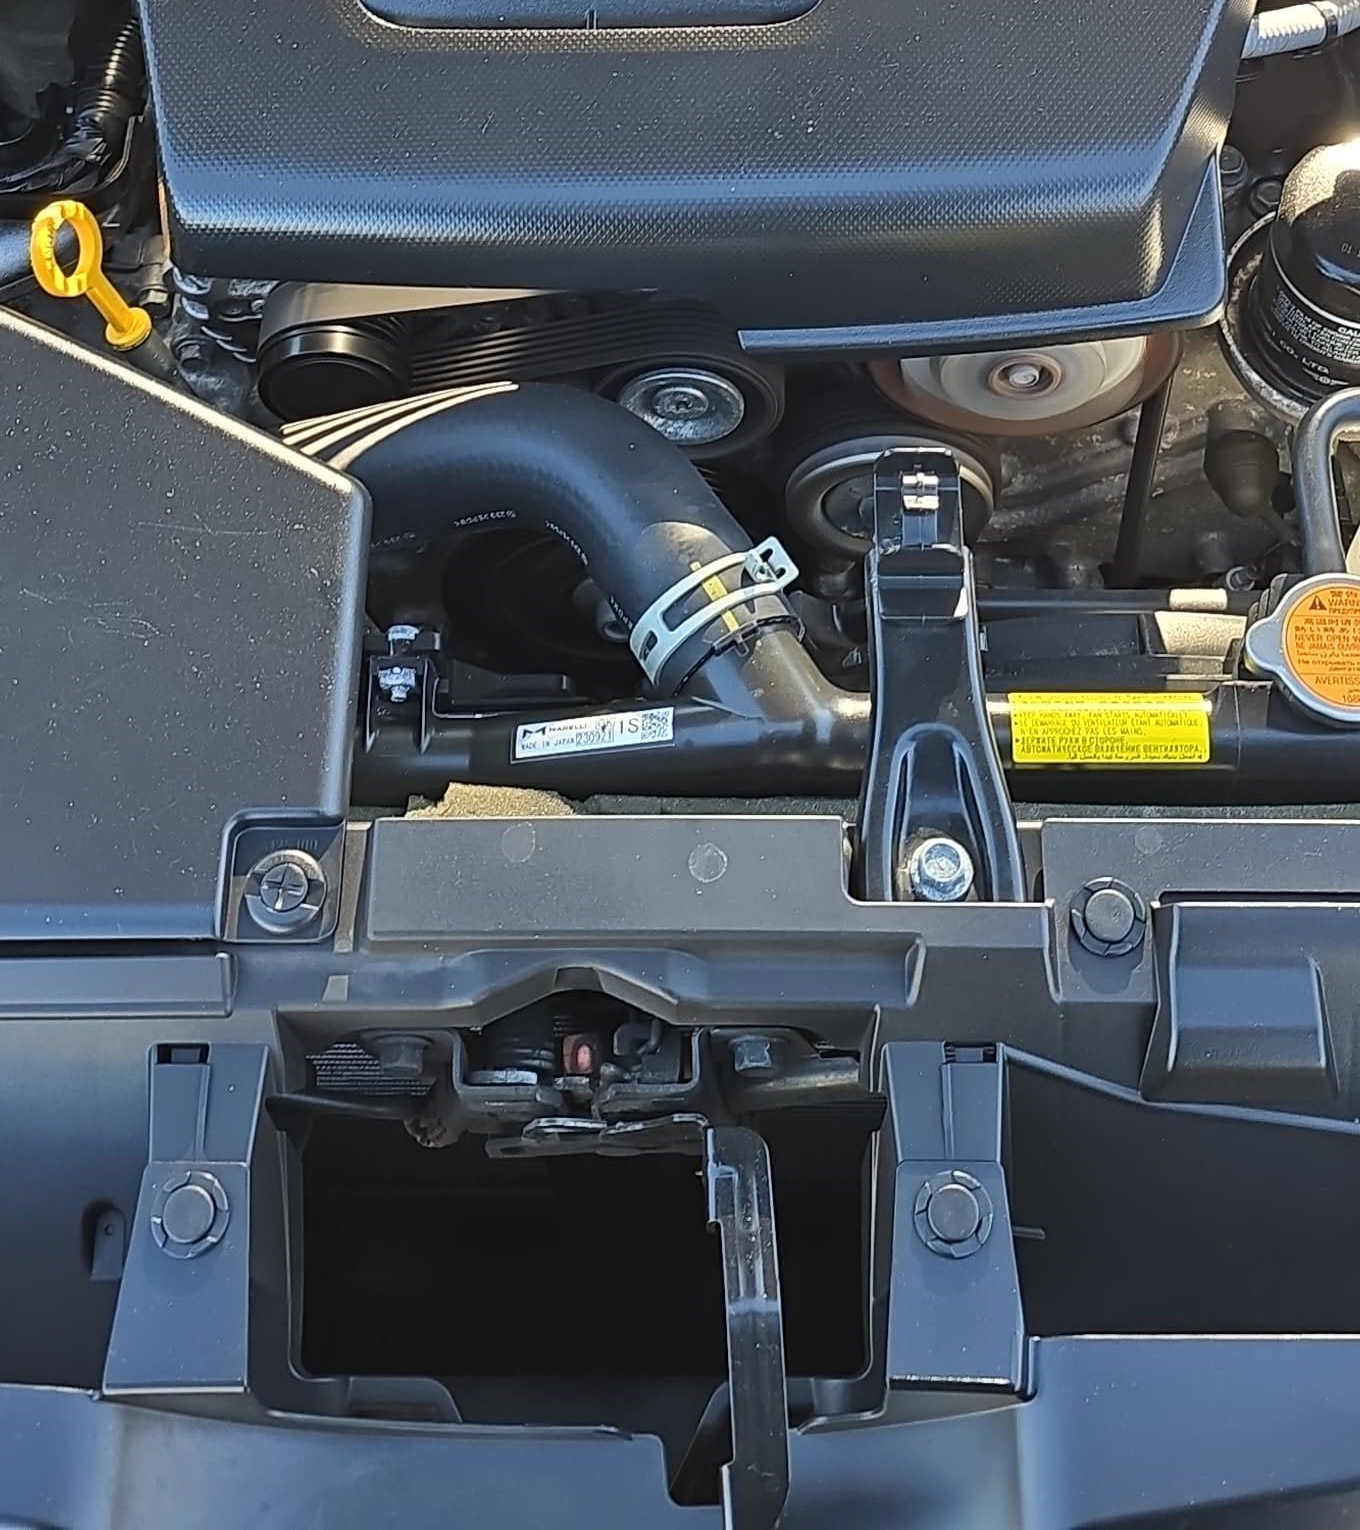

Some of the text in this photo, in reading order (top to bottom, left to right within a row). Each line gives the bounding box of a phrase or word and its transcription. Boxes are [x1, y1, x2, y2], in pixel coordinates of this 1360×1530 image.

[1340, 242, 1352, 254] 01
[1294, 633, 1323, 641] NEVER
[1326, 634, 1349, 642] OPEN
[549, 723, 587, 733] MARELLI
[521, 732, 613, 751] MADE IN JAPAN 230921
